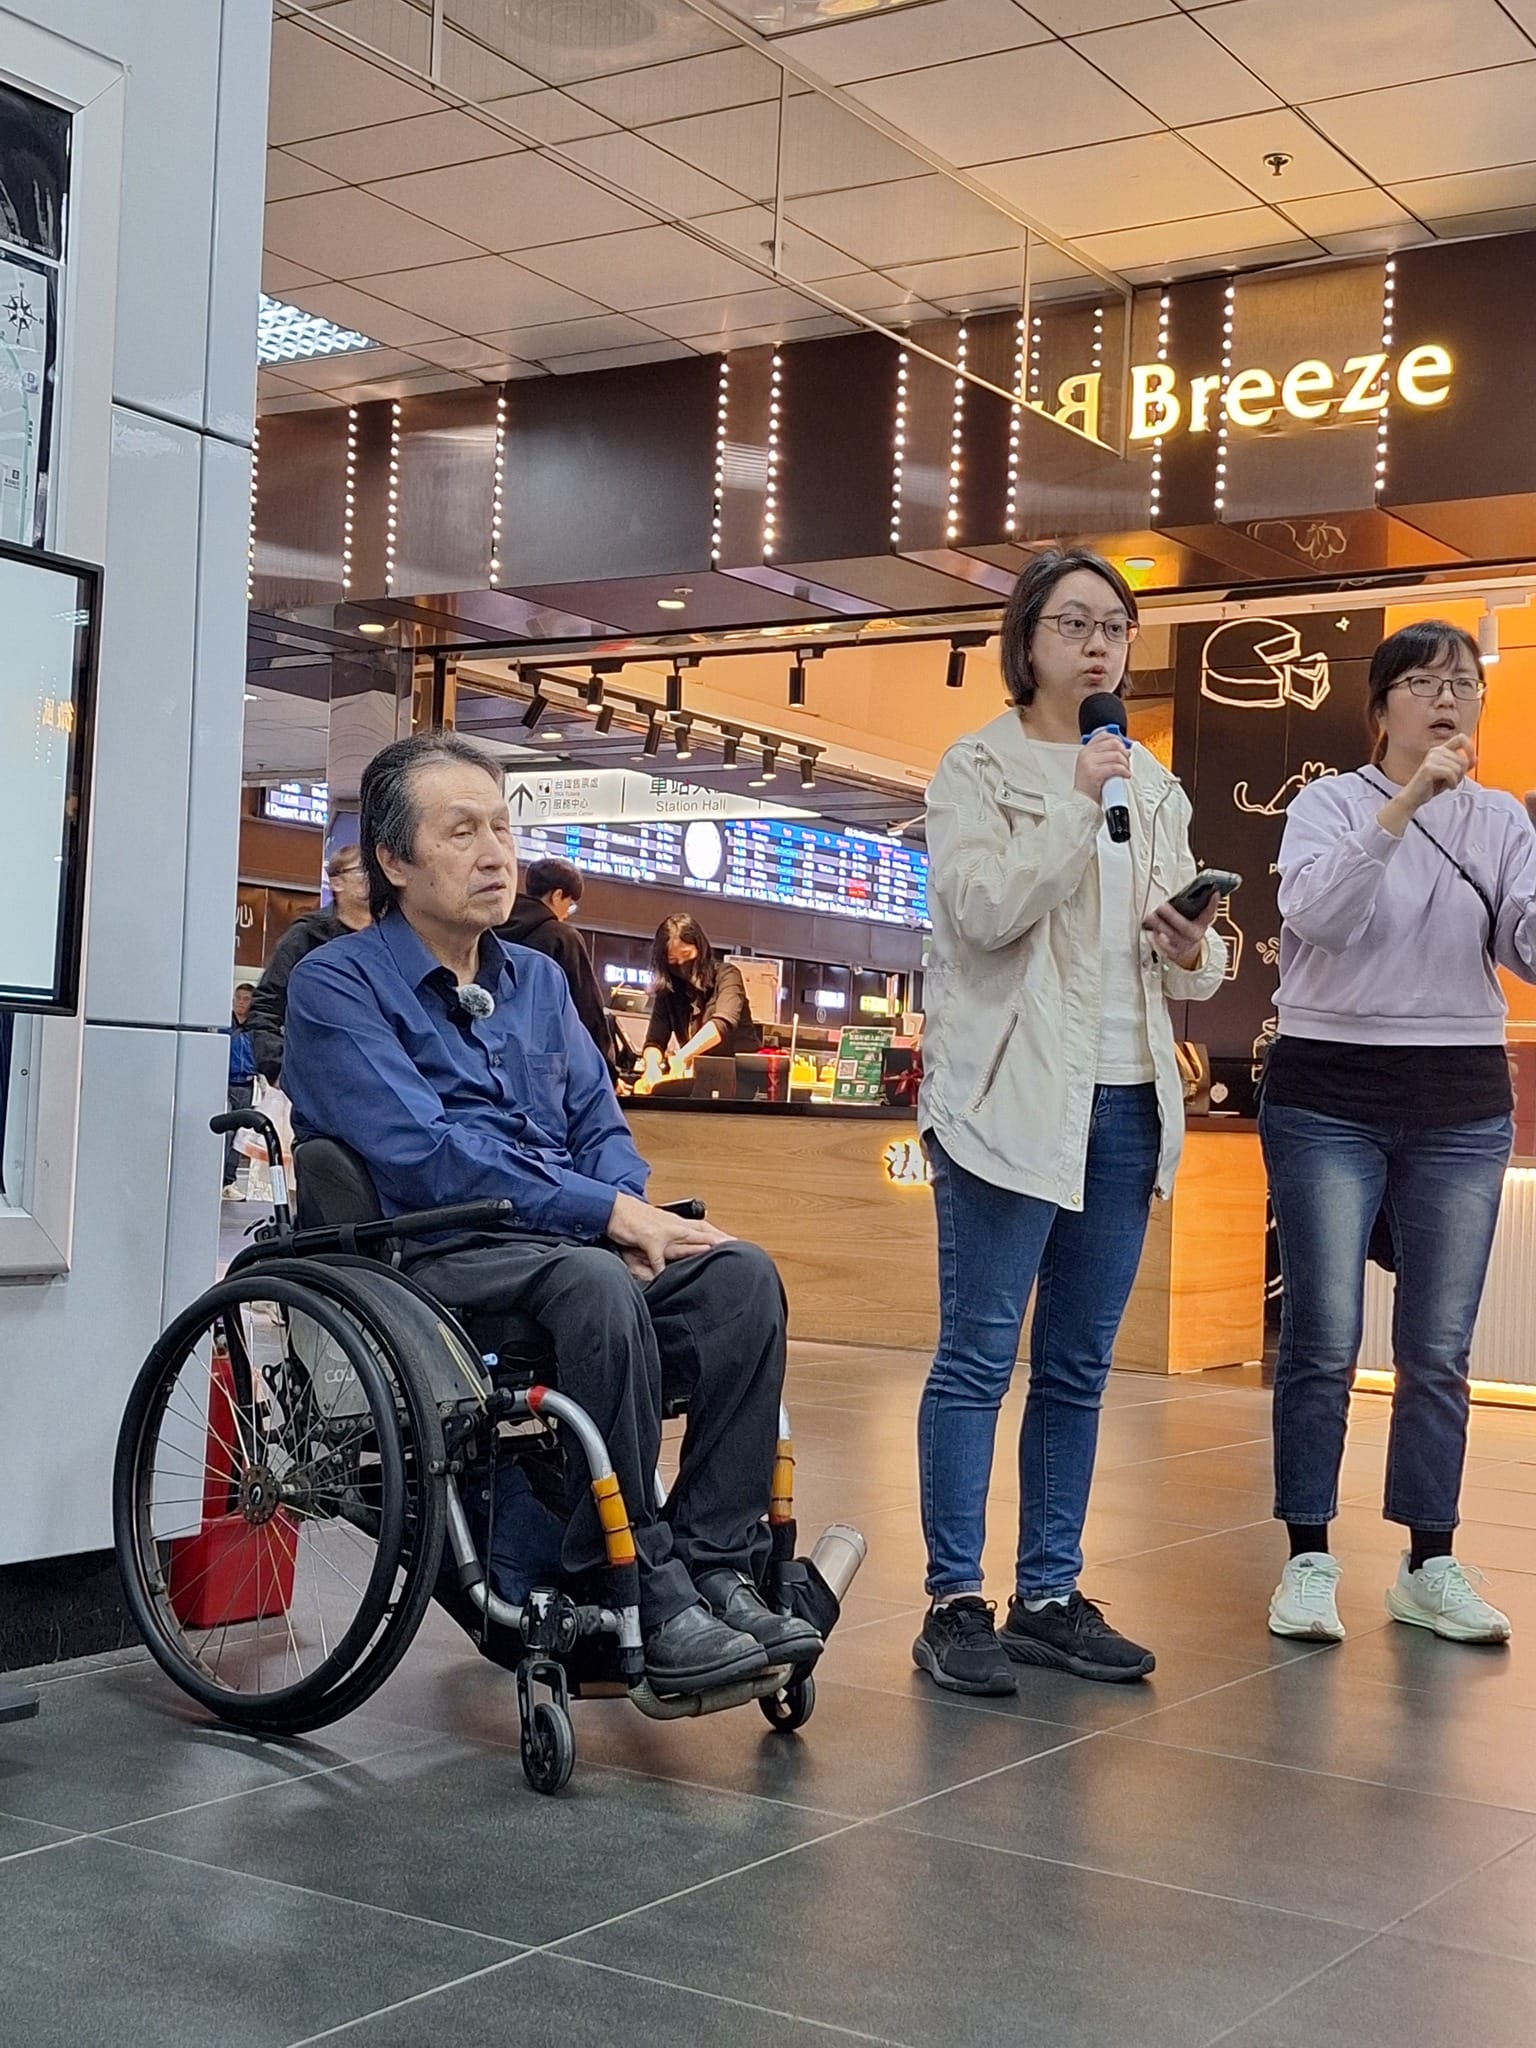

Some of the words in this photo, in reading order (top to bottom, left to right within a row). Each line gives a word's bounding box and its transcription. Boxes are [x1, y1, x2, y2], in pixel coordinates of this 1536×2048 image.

[1129, 345, 1453, 440] Breeze
[656, 800, 698, 812] Station
[702, 799, 726, 811] Hall
